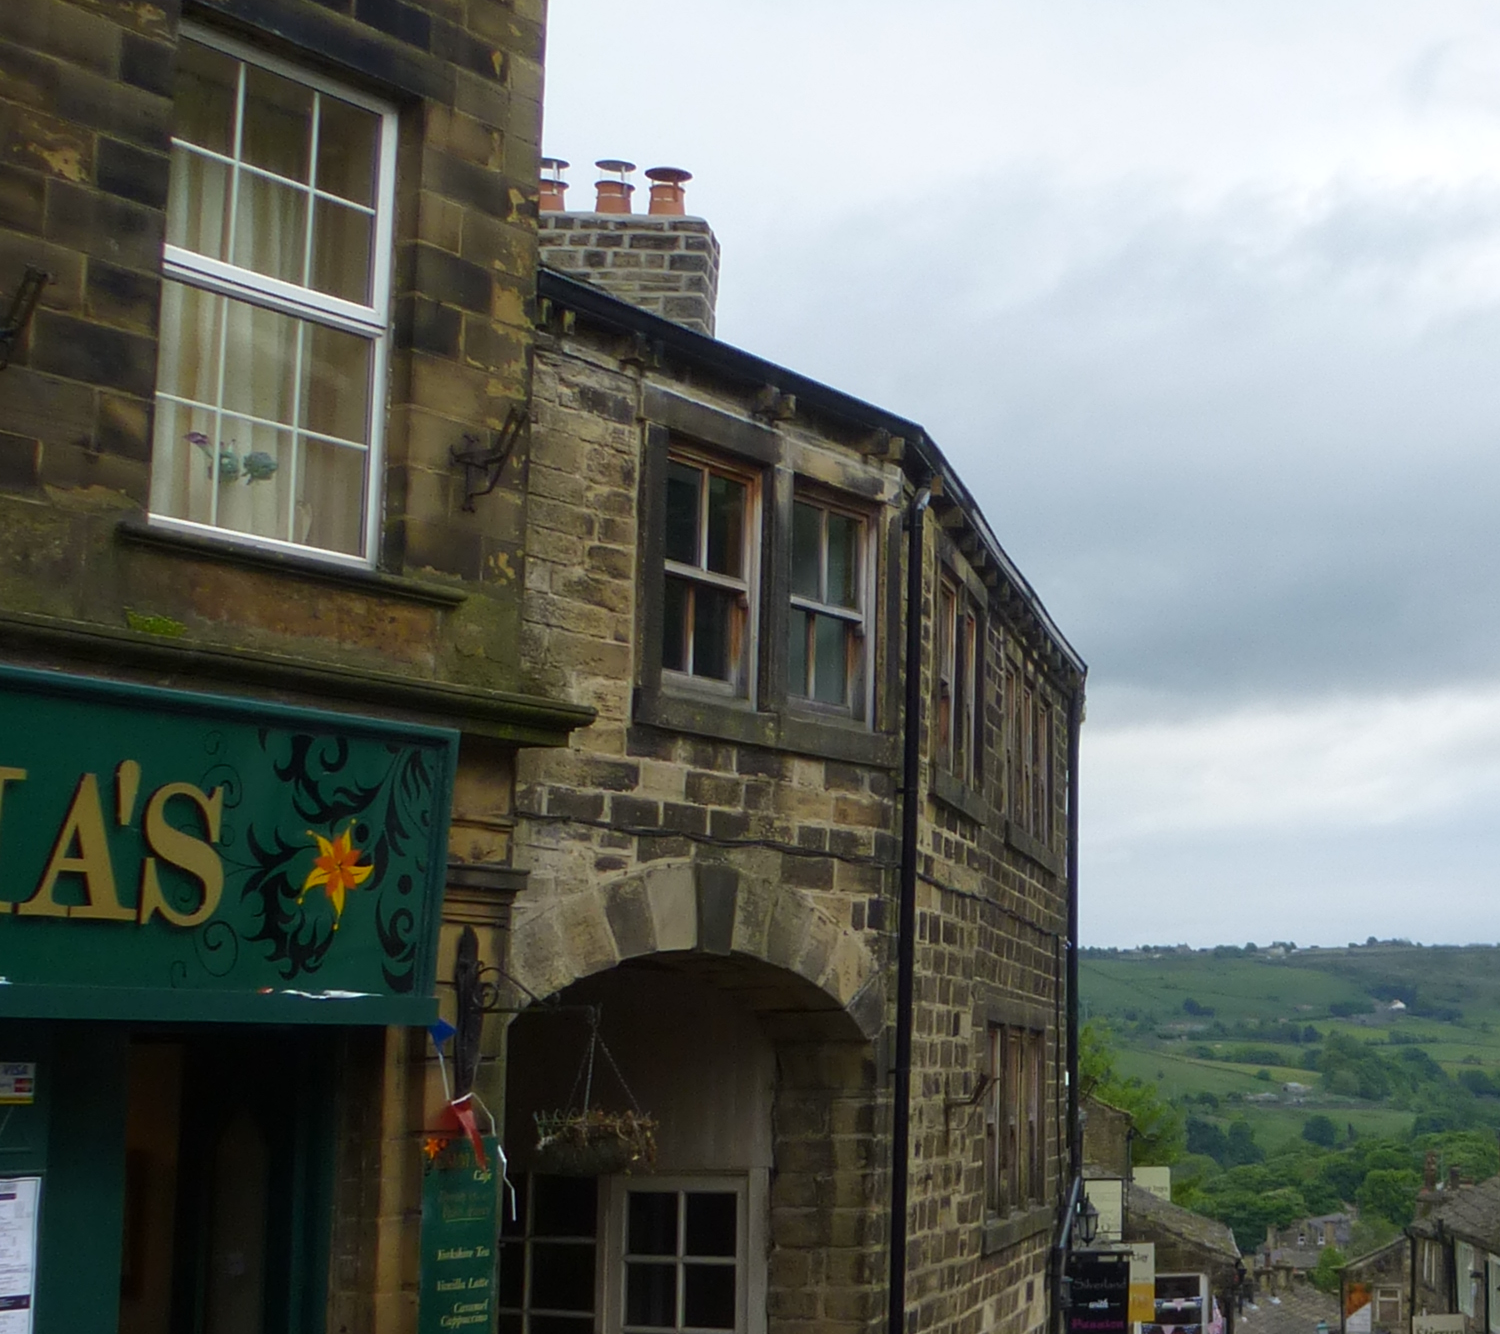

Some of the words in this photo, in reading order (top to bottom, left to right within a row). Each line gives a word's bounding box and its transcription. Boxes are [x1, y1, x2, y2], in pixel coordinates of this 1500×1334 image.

[0, 760, 226, 928] A'S
[476, 1245, 490, 1257] Tea
[436, 1278, 466, 1292] Vanilla
[468, 1276, 489, 1289] Latte
[1072, 1277, 1127, 1291] Silverland
[453, 1298, 489, 1314] Caramel
[440, 1312, 488, 1329] Cappuccino
